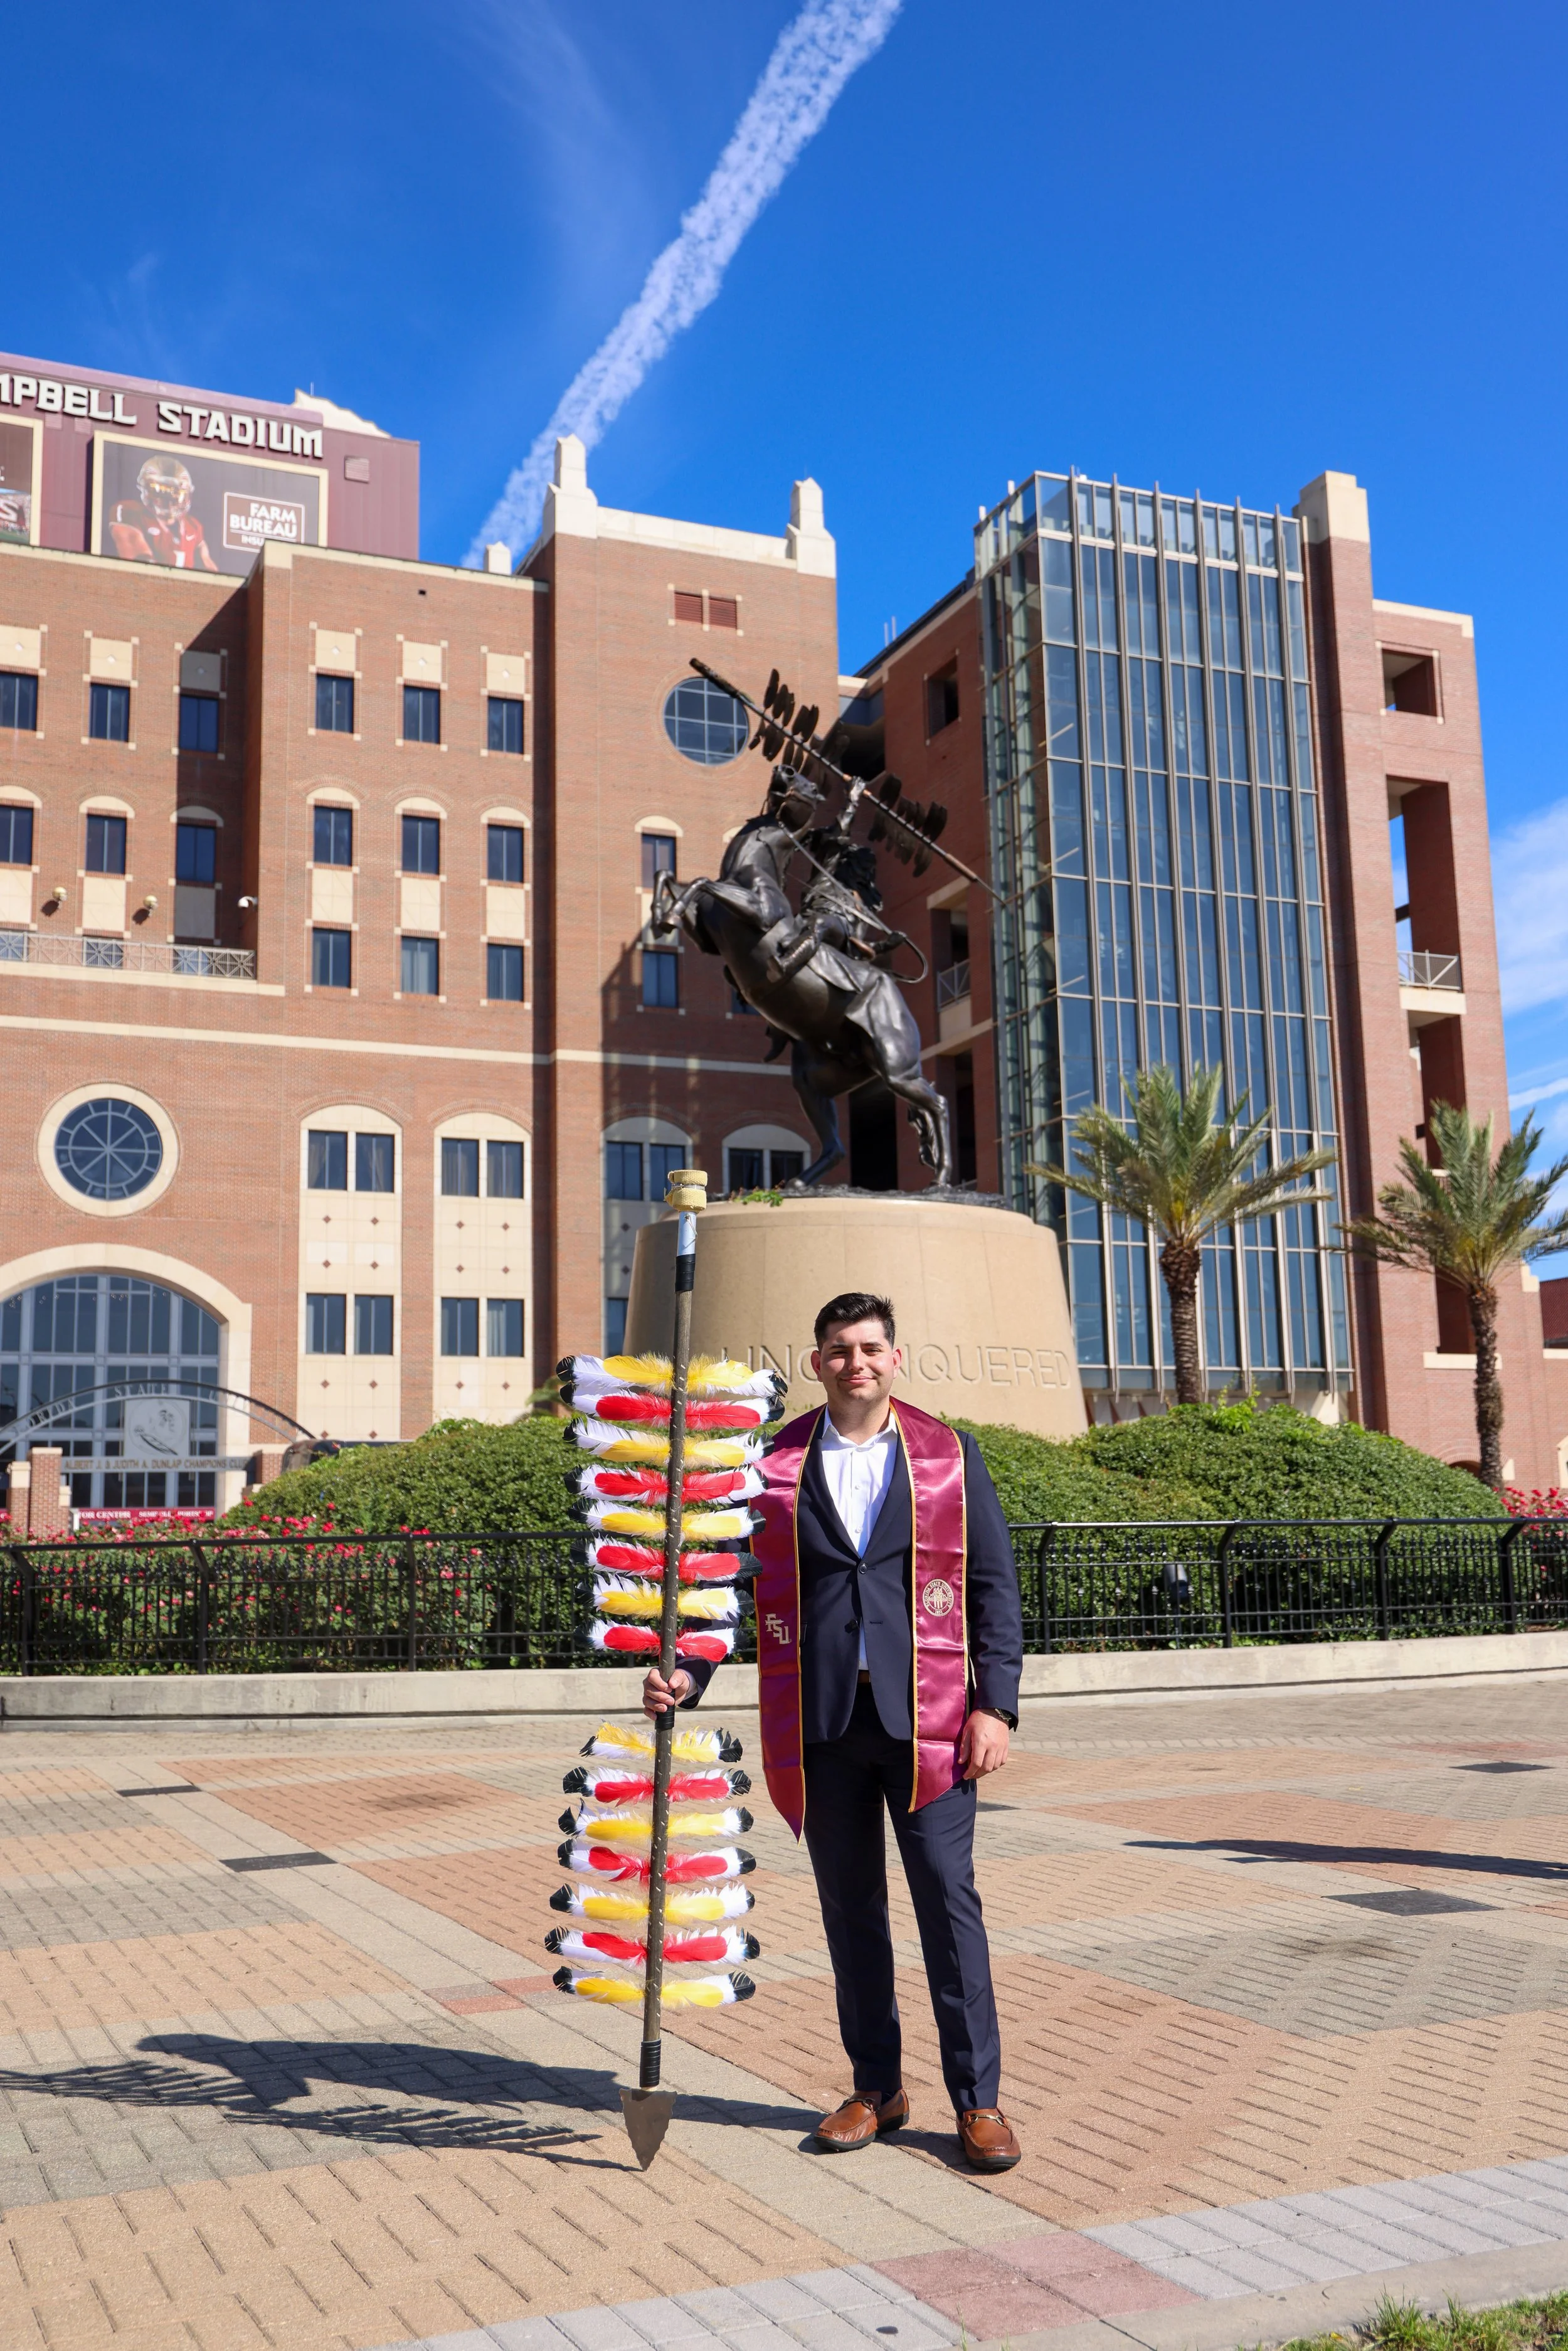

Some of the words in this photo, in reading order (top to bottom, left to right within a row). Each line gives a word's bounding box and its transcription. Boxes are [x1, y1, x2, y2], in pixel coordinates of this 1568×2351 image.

[158, 401, 323, 458] STADIUM
[250, 502, 296, 524] FARM
[230, 514, 297, 538] BUREAU
[115, 1383, 168, 1398] STATE
[65, 1460, 93, 1469] ALBERT
[114, 1459, 139, 1469] JUDITH
[151, 1460, 182, 1469] DUNLAP
[184, 1459, 226, 1468] CHAMPIONS
[96, 1510, 131, 1519] CENTER
[765, 1613, 790, 1644] FSU
